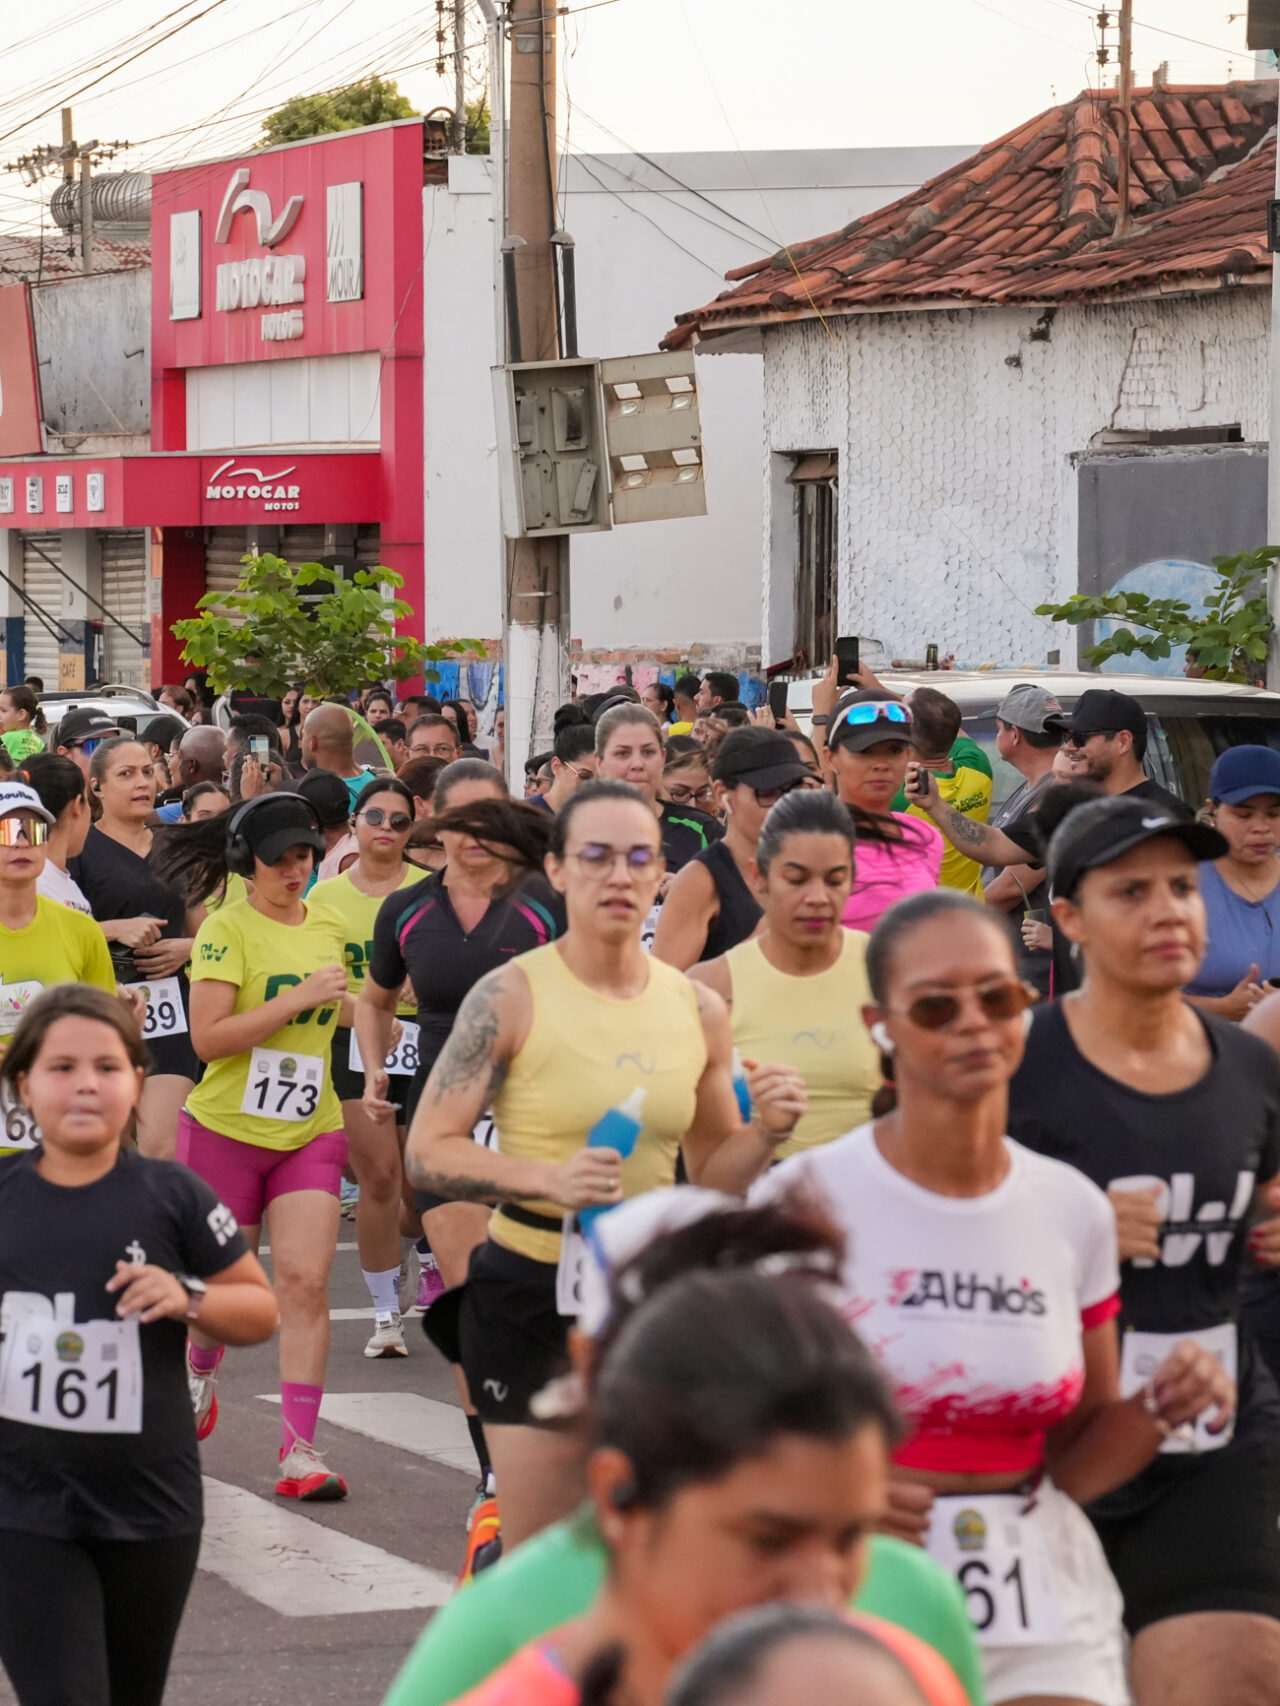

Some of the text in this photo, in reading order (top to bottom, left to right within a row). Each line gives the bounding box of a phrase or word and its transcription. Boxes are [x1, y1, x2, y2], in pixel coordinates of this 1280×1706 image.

[206, 485, 300, 499] MOTOCAR
[264, 502, 300, 511] MOTOS
[254, 1077, 318, 1117] 173
[22, 1361, 118, 1421] 161
